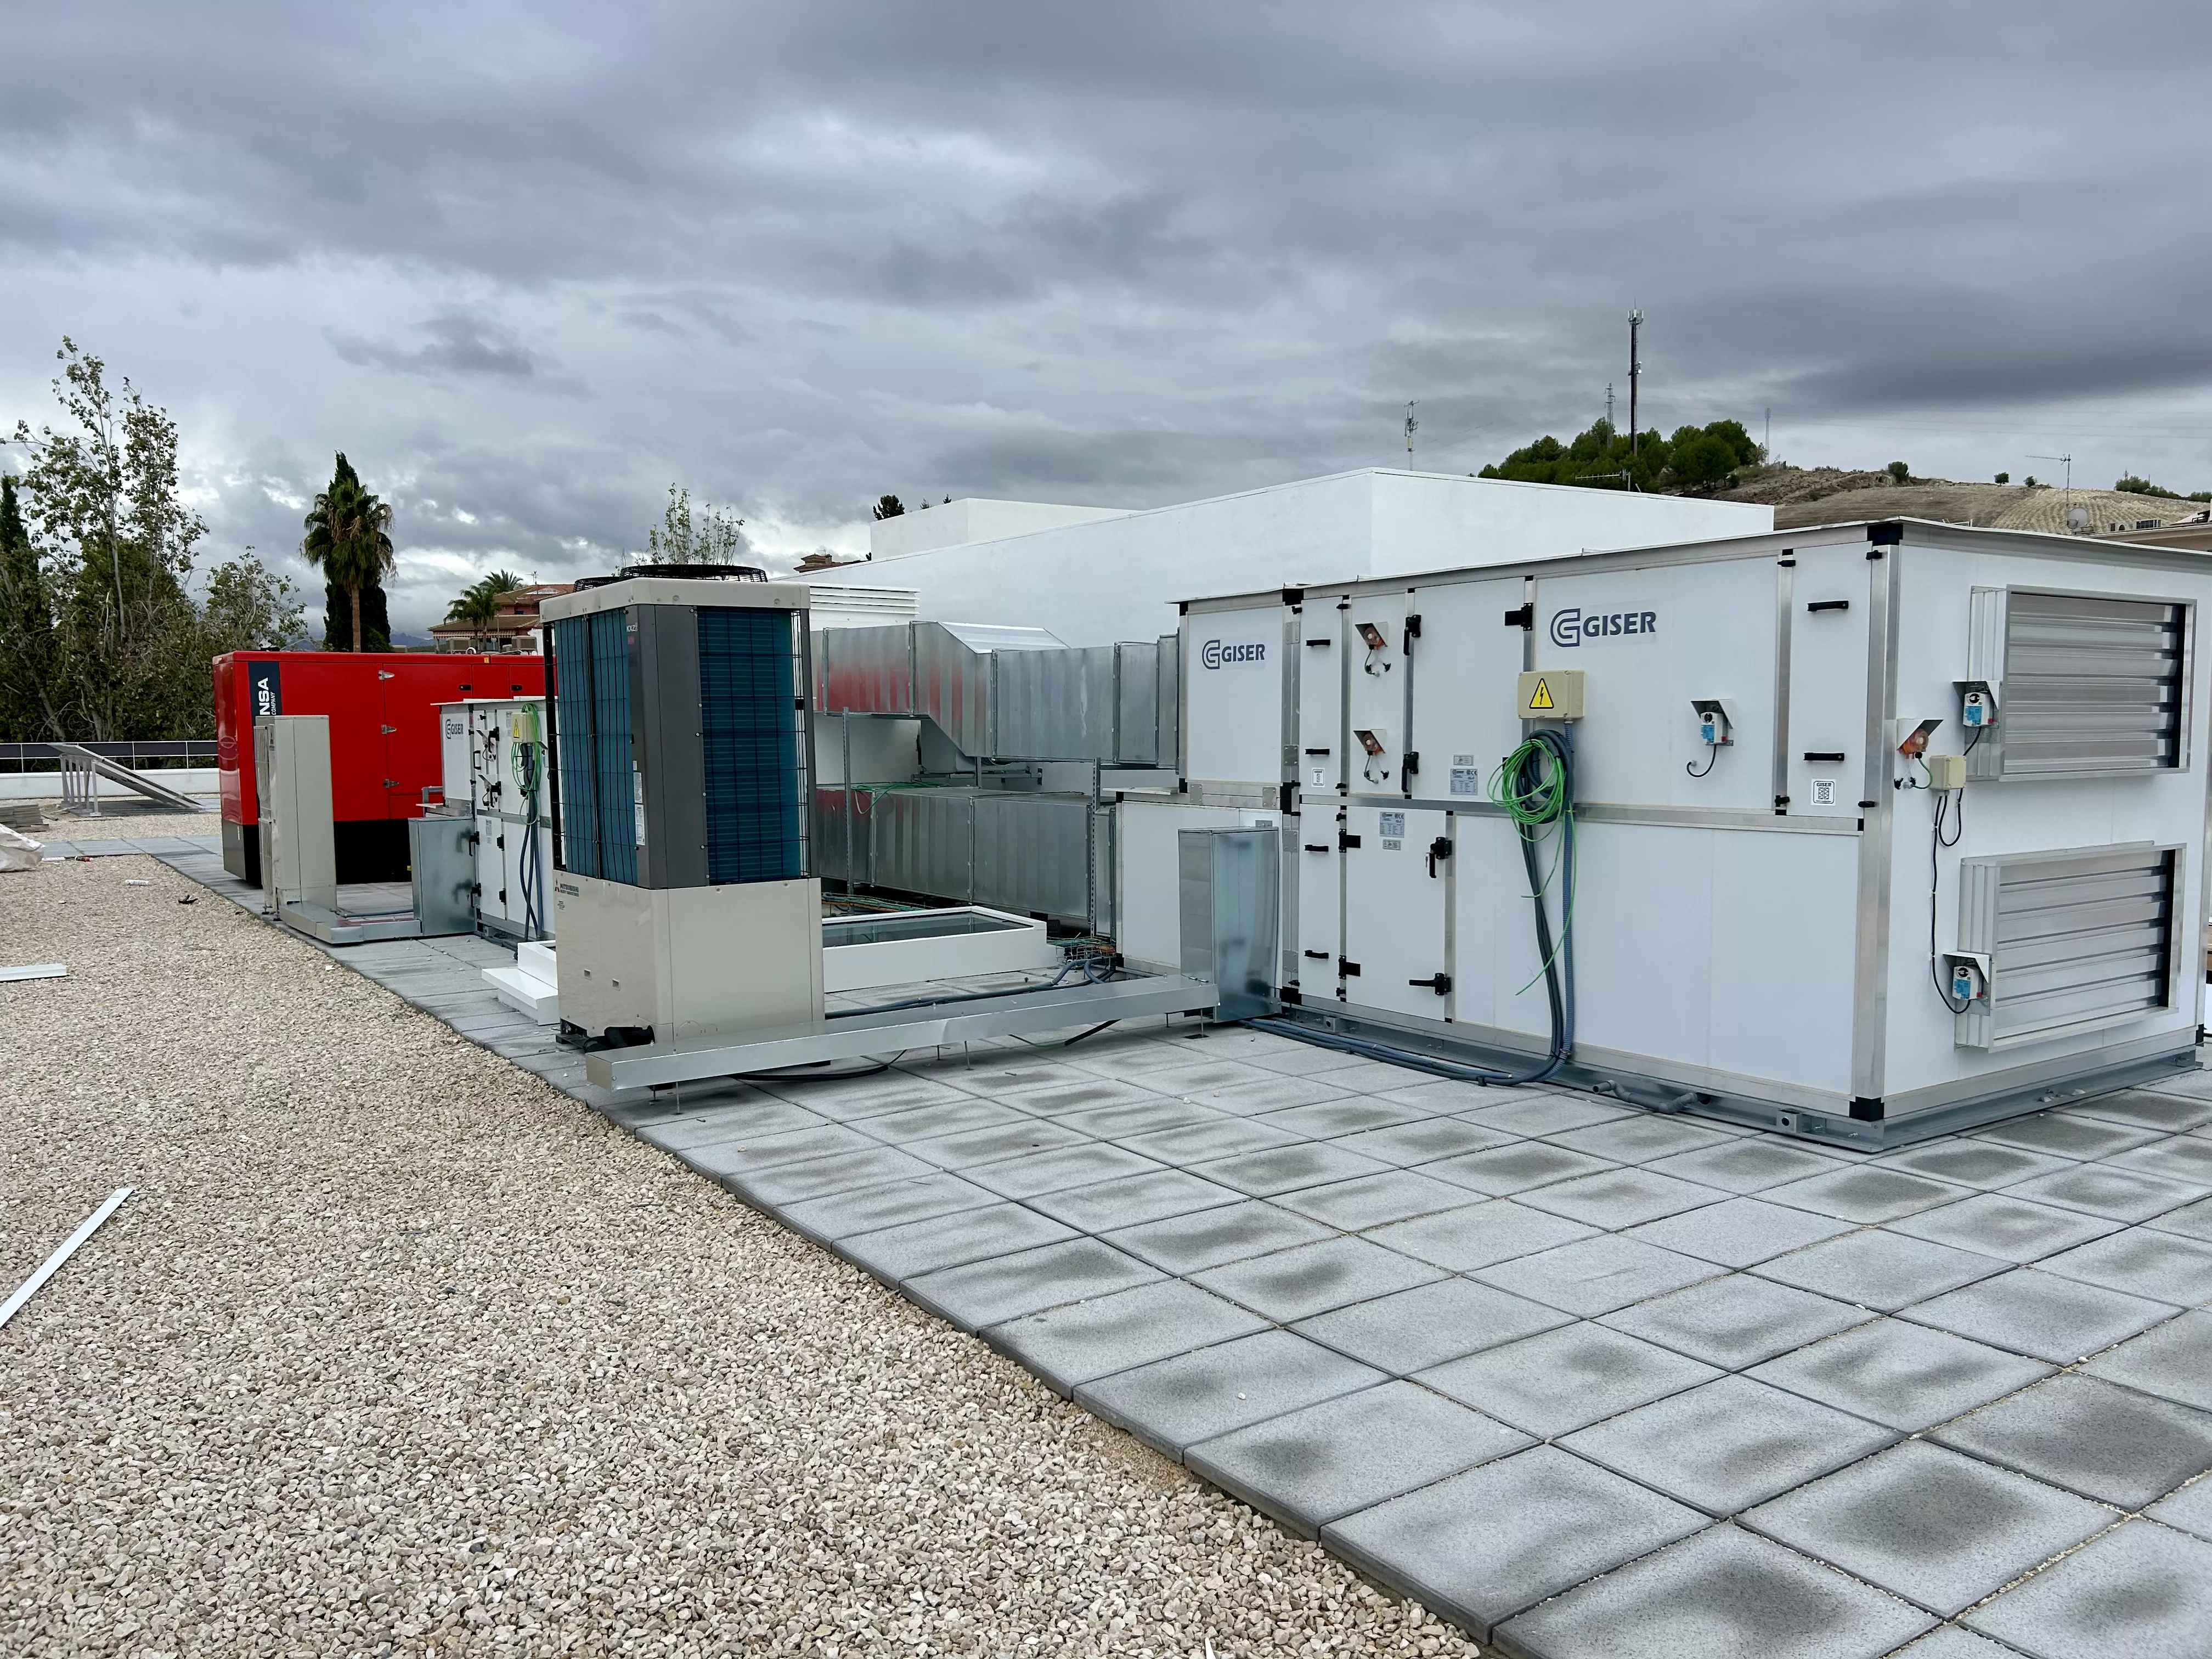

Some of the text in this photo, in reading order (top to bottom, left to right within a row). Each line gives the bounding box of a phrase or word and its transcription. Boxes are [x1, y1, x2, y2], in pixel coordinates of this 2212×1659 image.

[1583, 611, 1656, 637] GISER
[1221, 644, 1265, 663] GISER
[450, 723, 464, 735] GISER
